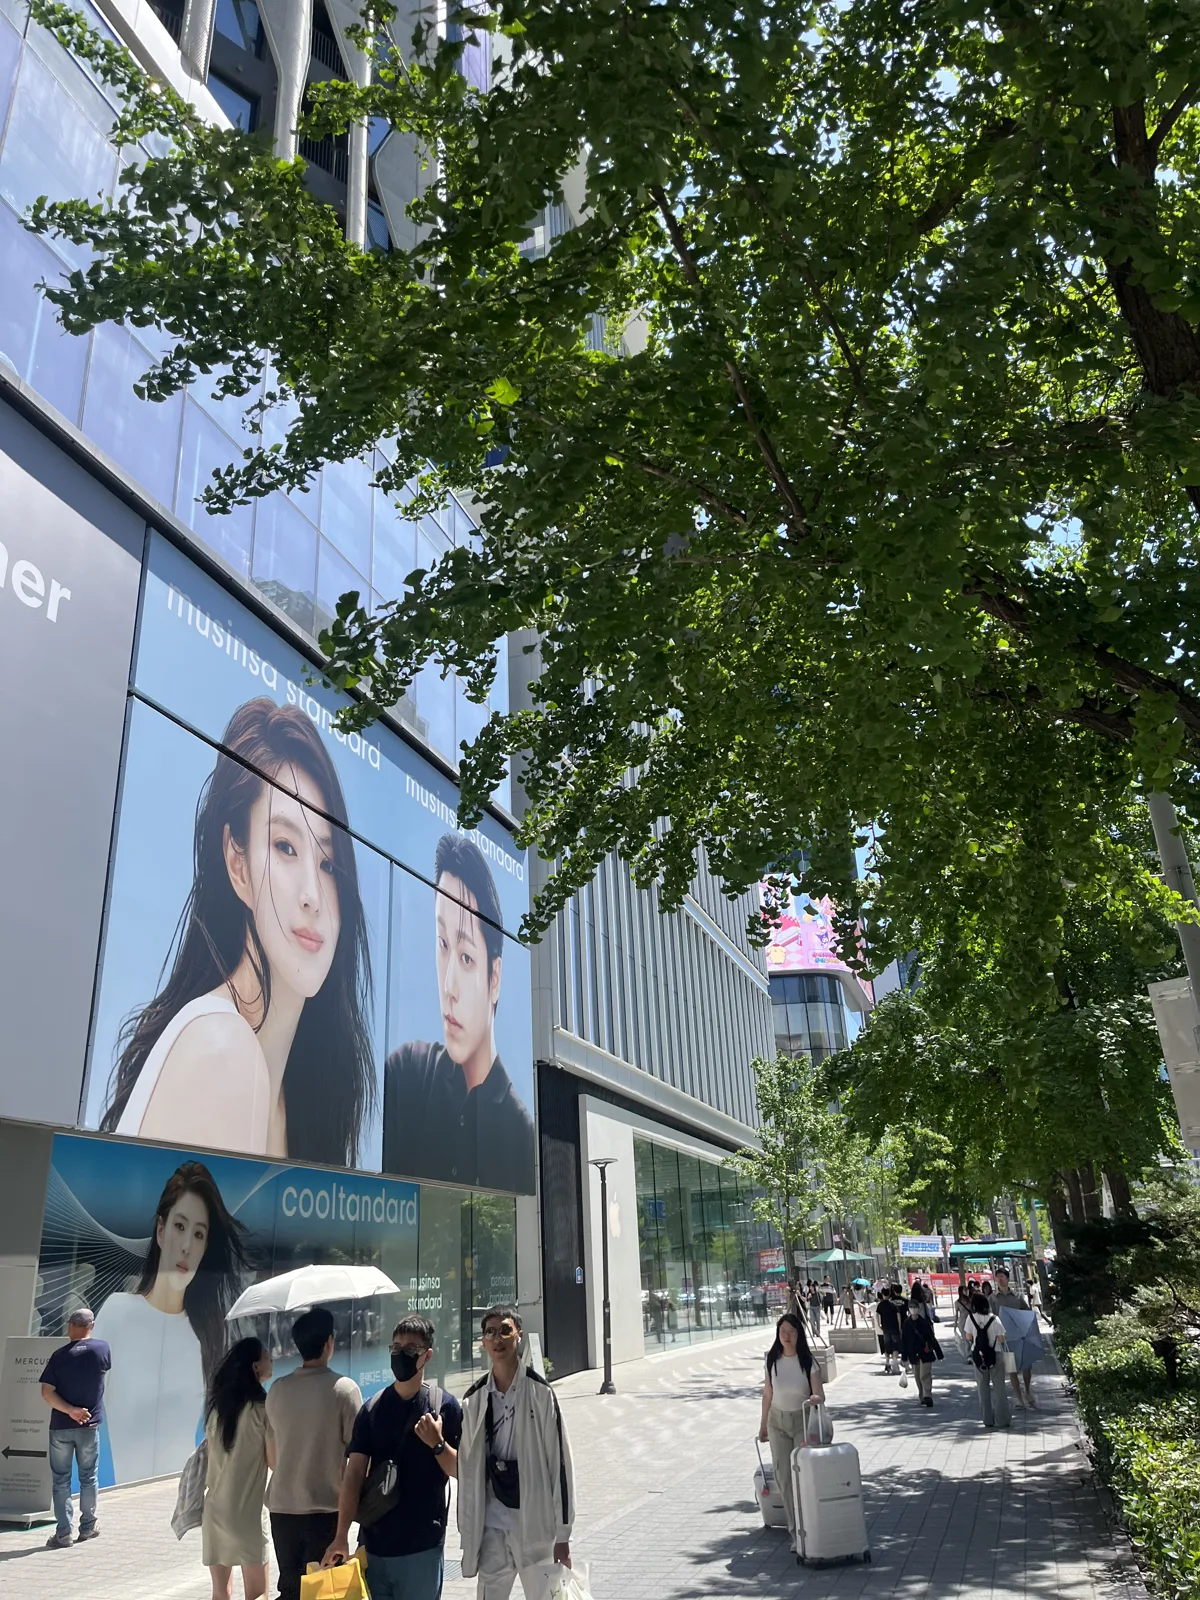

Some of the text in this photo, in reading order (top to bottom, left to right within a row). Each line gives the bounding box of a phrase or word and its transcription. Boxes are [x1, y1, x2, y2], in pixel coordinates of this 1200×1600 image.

[0, 541, 72, 623] er
[167, 582, 278, 691] musinsa
[282, 1182, 417, 1225] cooltandard
[407, 1293, 443, 1311] standard
